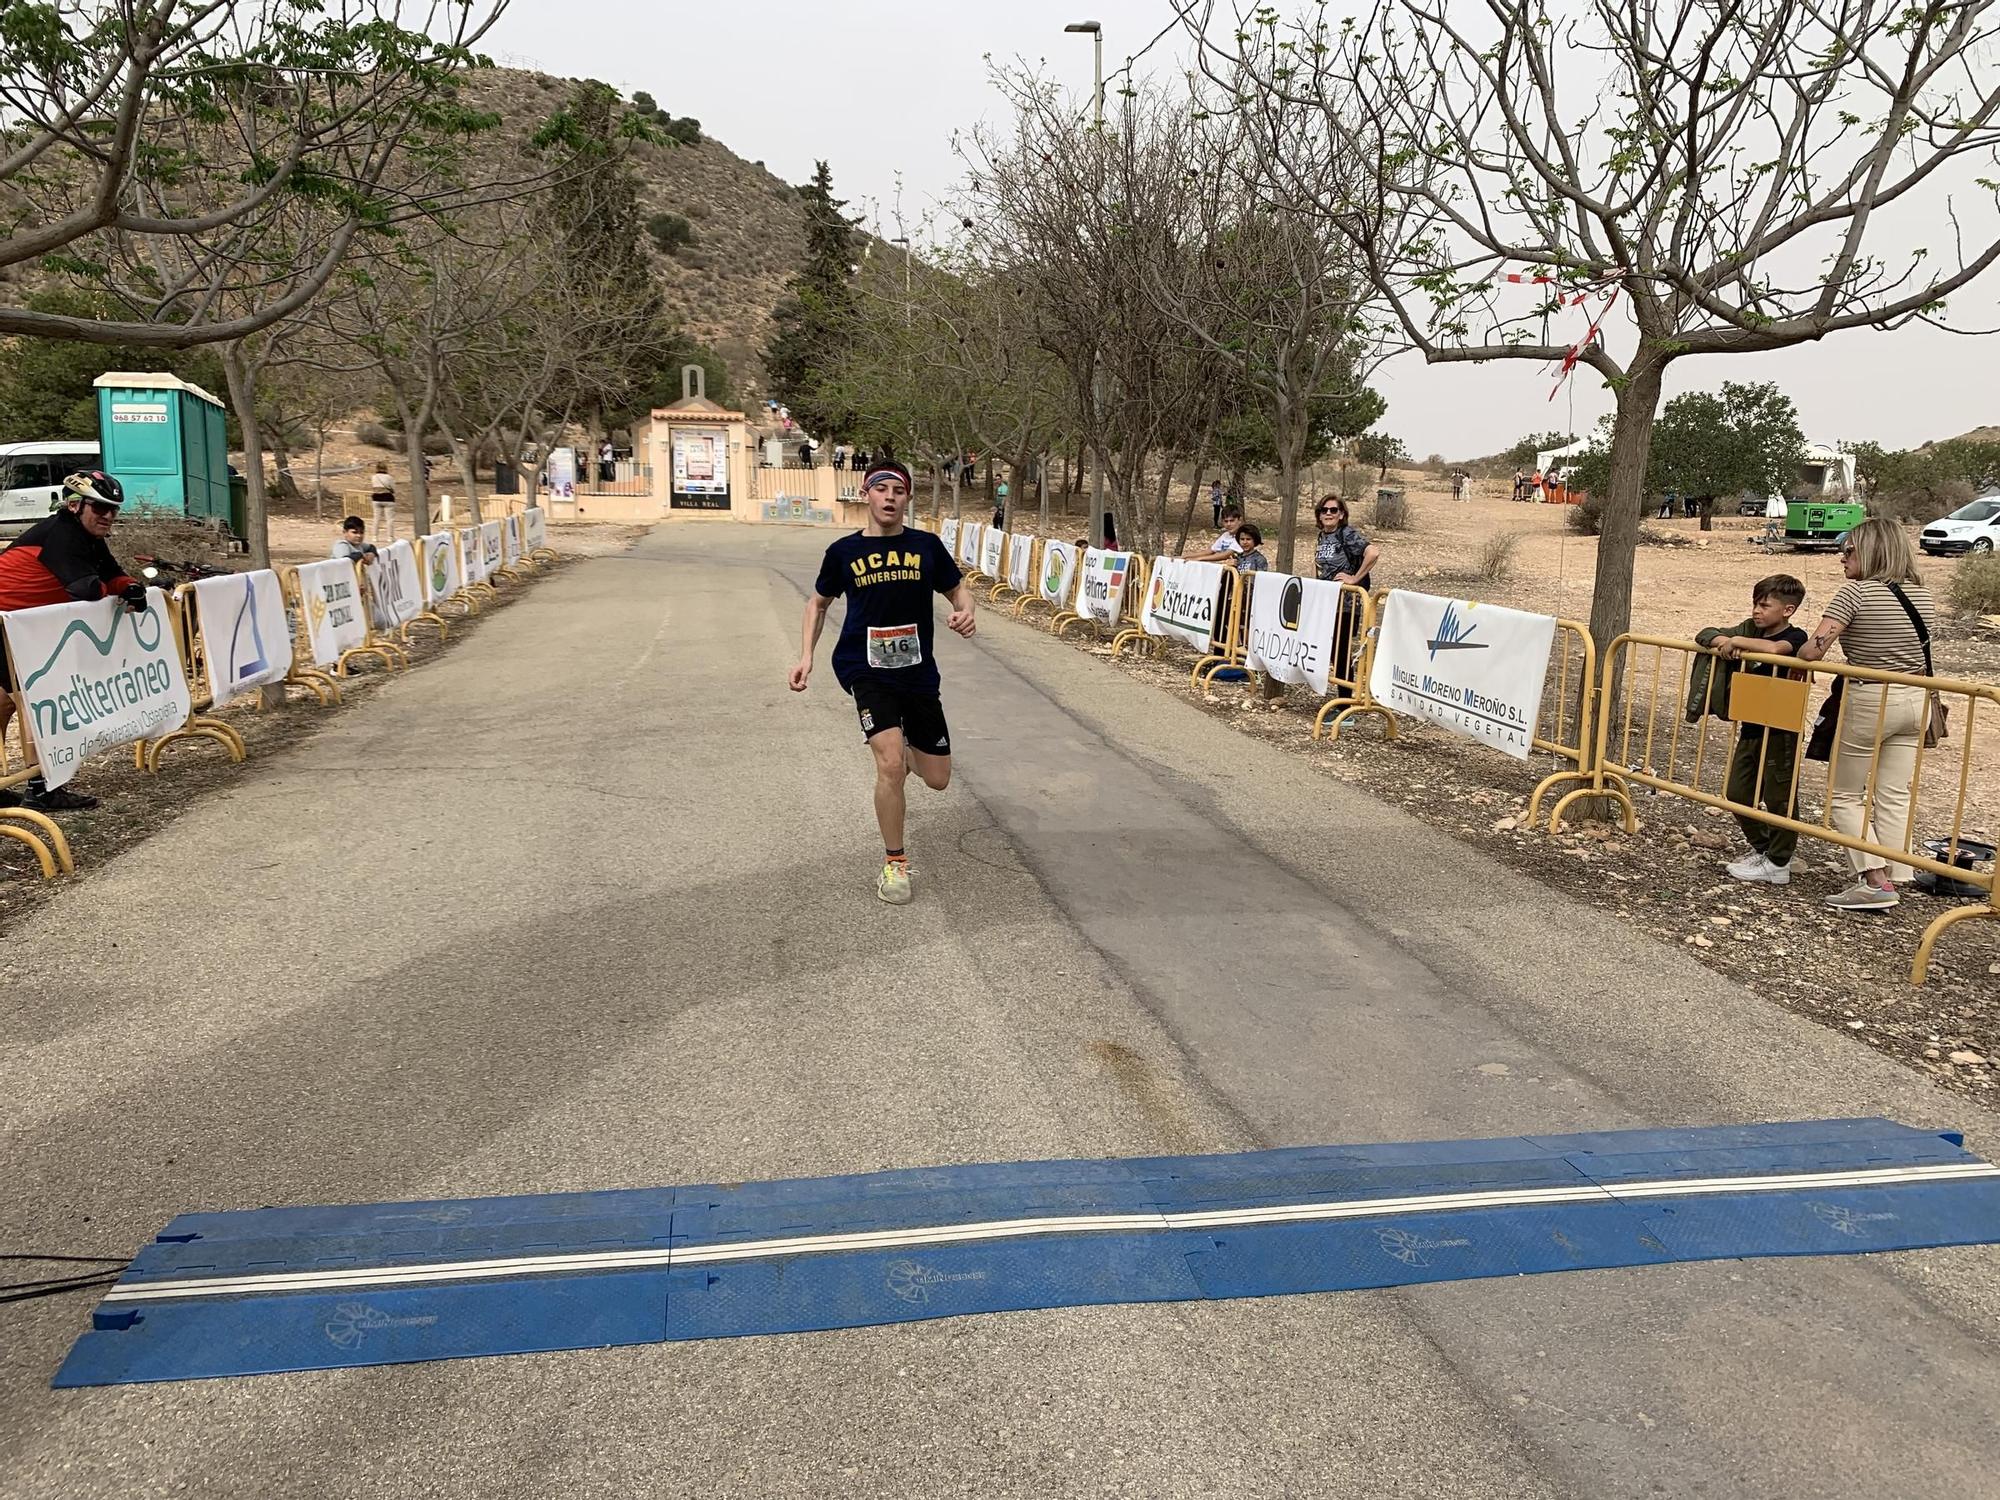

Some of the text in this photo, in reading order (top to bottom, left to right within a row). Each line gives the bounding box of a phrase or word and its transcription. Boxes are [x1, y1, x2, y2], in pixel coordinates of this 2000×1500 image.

[850, 550, 921, 577] UCAM
[855, 569, 921, 588] UNIVERSIDAD
[1162, 589, 1212, 623] esparza
[879, 639, 909, 654] 116
[1392, 664, 1527, 725] MIGUEL MORENO MEROÑO S.L.
[1390, 688, 1526, 748] SANIDAD VEGETAL
